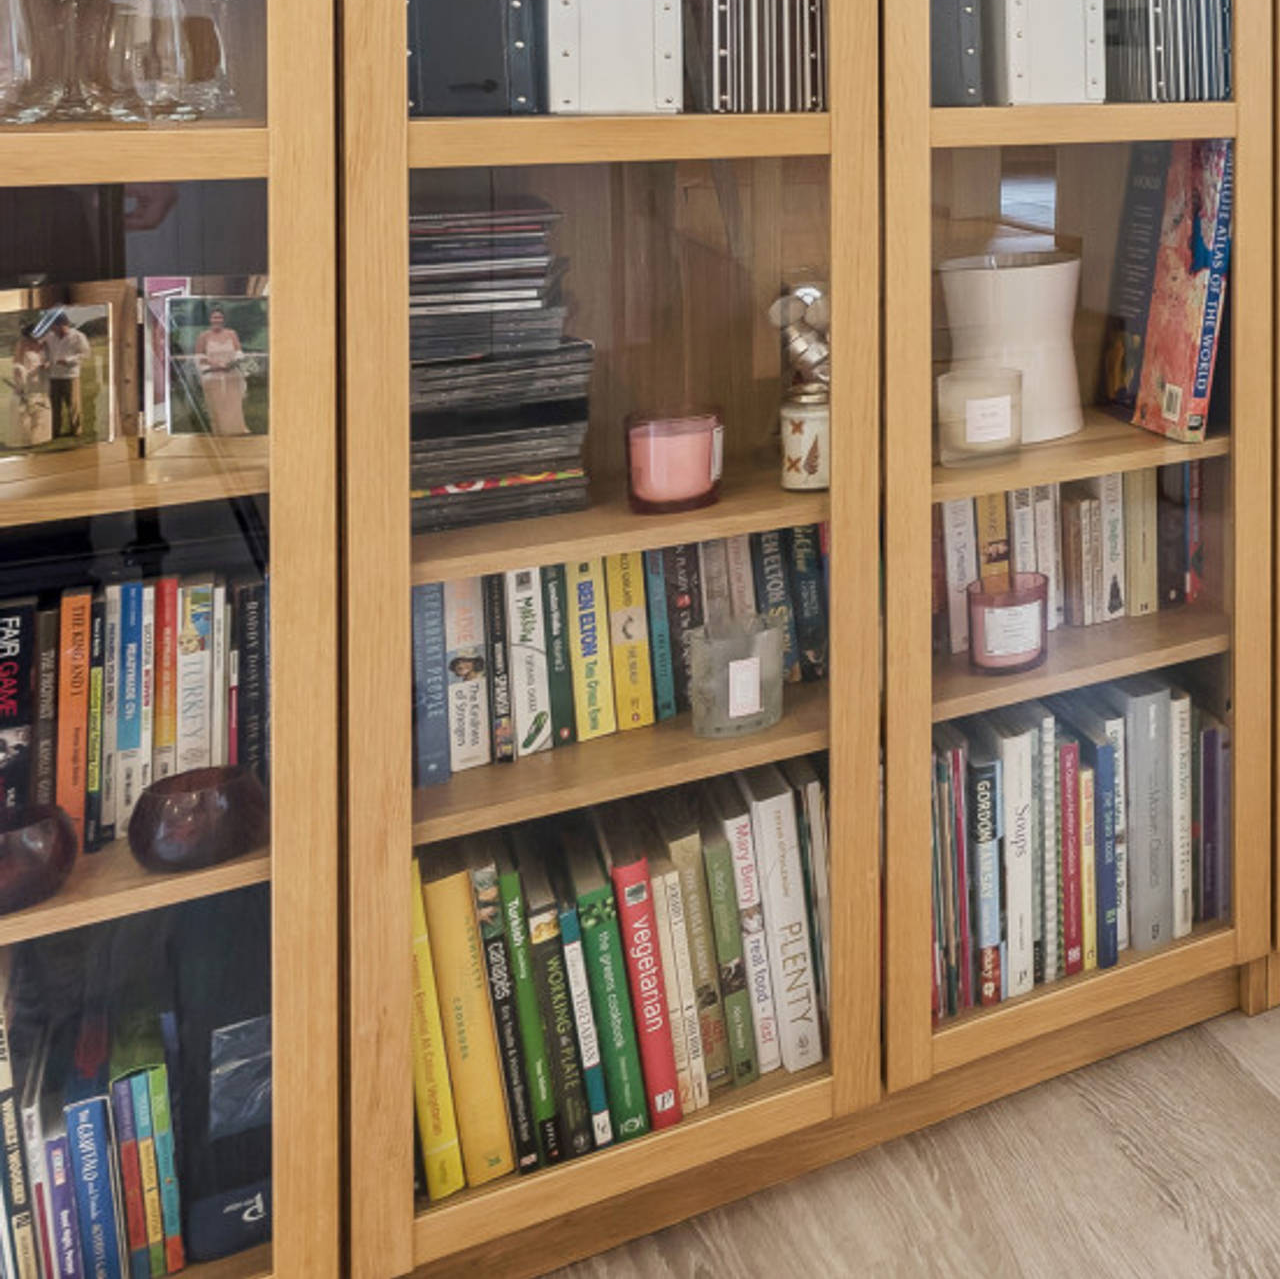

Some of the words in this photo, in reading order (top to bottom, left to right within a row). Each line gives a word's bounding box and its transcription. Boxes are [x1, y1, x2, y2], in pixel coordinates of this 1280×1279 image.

[1210, 224, 1228, 269] ATLAS
[1208, 273, 1222, 293] OF
[1203, 300, 1219, 328] THE
[1195, 333, 1214, 391] WORLD
[71, 604, 86, 629] THE
[577, 580, 595, 611] BEN
[70, 631, 86, 661] KING
[579, 611, 598, 658] ELTON
[0, 661, 20, 718] GAME
[70, 664, 85, 688] AND
[182, 655, 205, 740] TURKEY
[454, 690, 466, 703] of
[468, 683, 479, 701] The
[468, 704, 481, 747] Kindness
[976, 780, 995, 844] GORDON
[1010, 804, 1031, 858] Soups
[734, 822, 754, 861] Mary
[737, 864, 757, 907] Berry
[507, 896, 525, 947] Turkish
[599, 931, 610, 951] the
[600, 954, 617, 992] greens
[628, 914, 664, 1033] vegetarian
[750, 937, 767, 967] real
[778, 920, 814, 1025] PLENTY
[753, 968, 772, 1003] food
[546, 954, 573, 1035] WORKING
[561, 1046, 579, 1090] PLATE
[575, 989, 598, 1063] VEGETARIAN
[606, 993, 625, 1048] cookbook
[760, 1015, 775, 1045] fast
